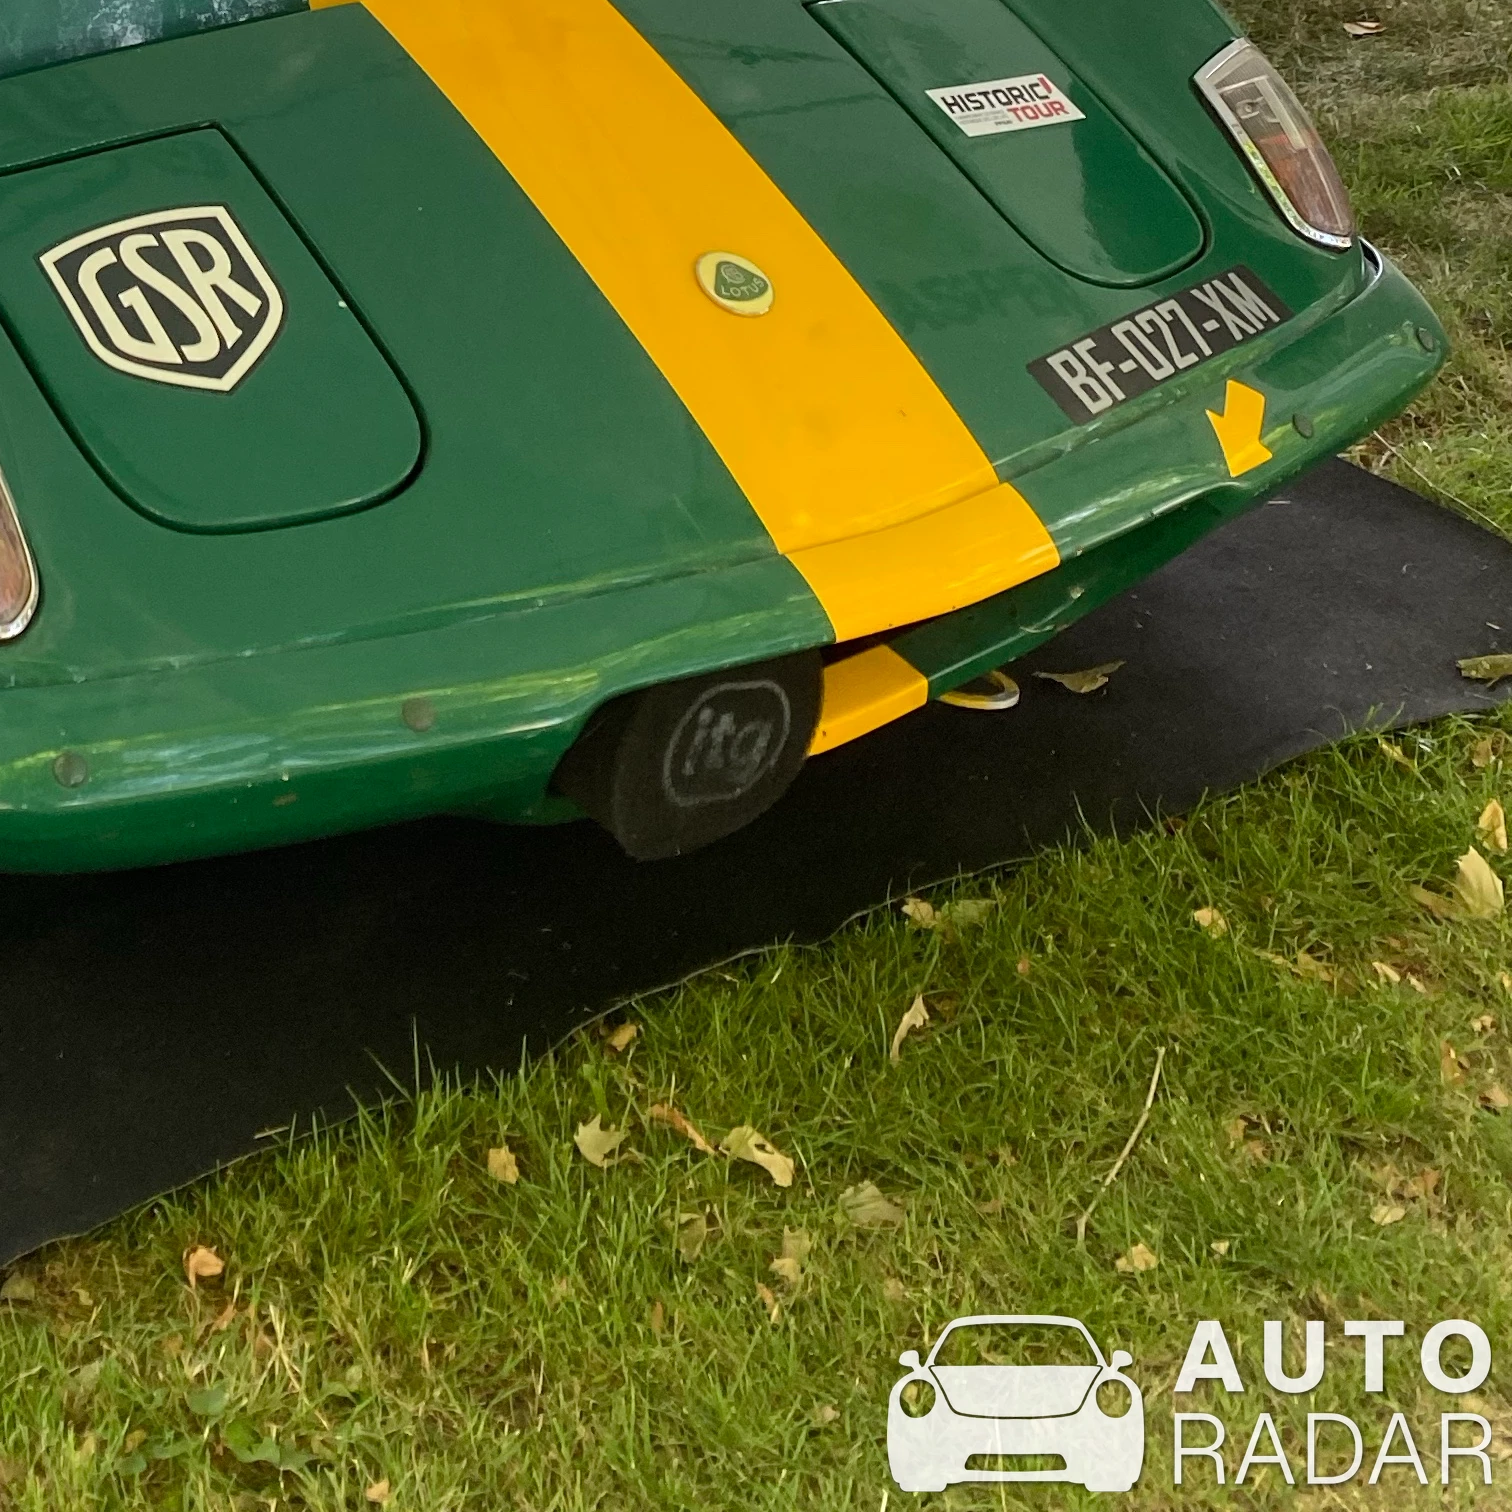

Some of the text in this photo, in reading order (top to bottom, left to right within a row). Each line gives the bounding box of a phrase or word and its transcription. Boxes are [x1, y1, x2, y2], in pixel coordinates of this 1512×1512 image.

[940, 82, 1050, 114] HISTORIC
[1007, 100, 1070, 123] TOUR
[77, 228, 263, 365] GSR
[720, 277, 765, 297] LOTUS
[1046, 272, 1281, 416] BF-027-XM
